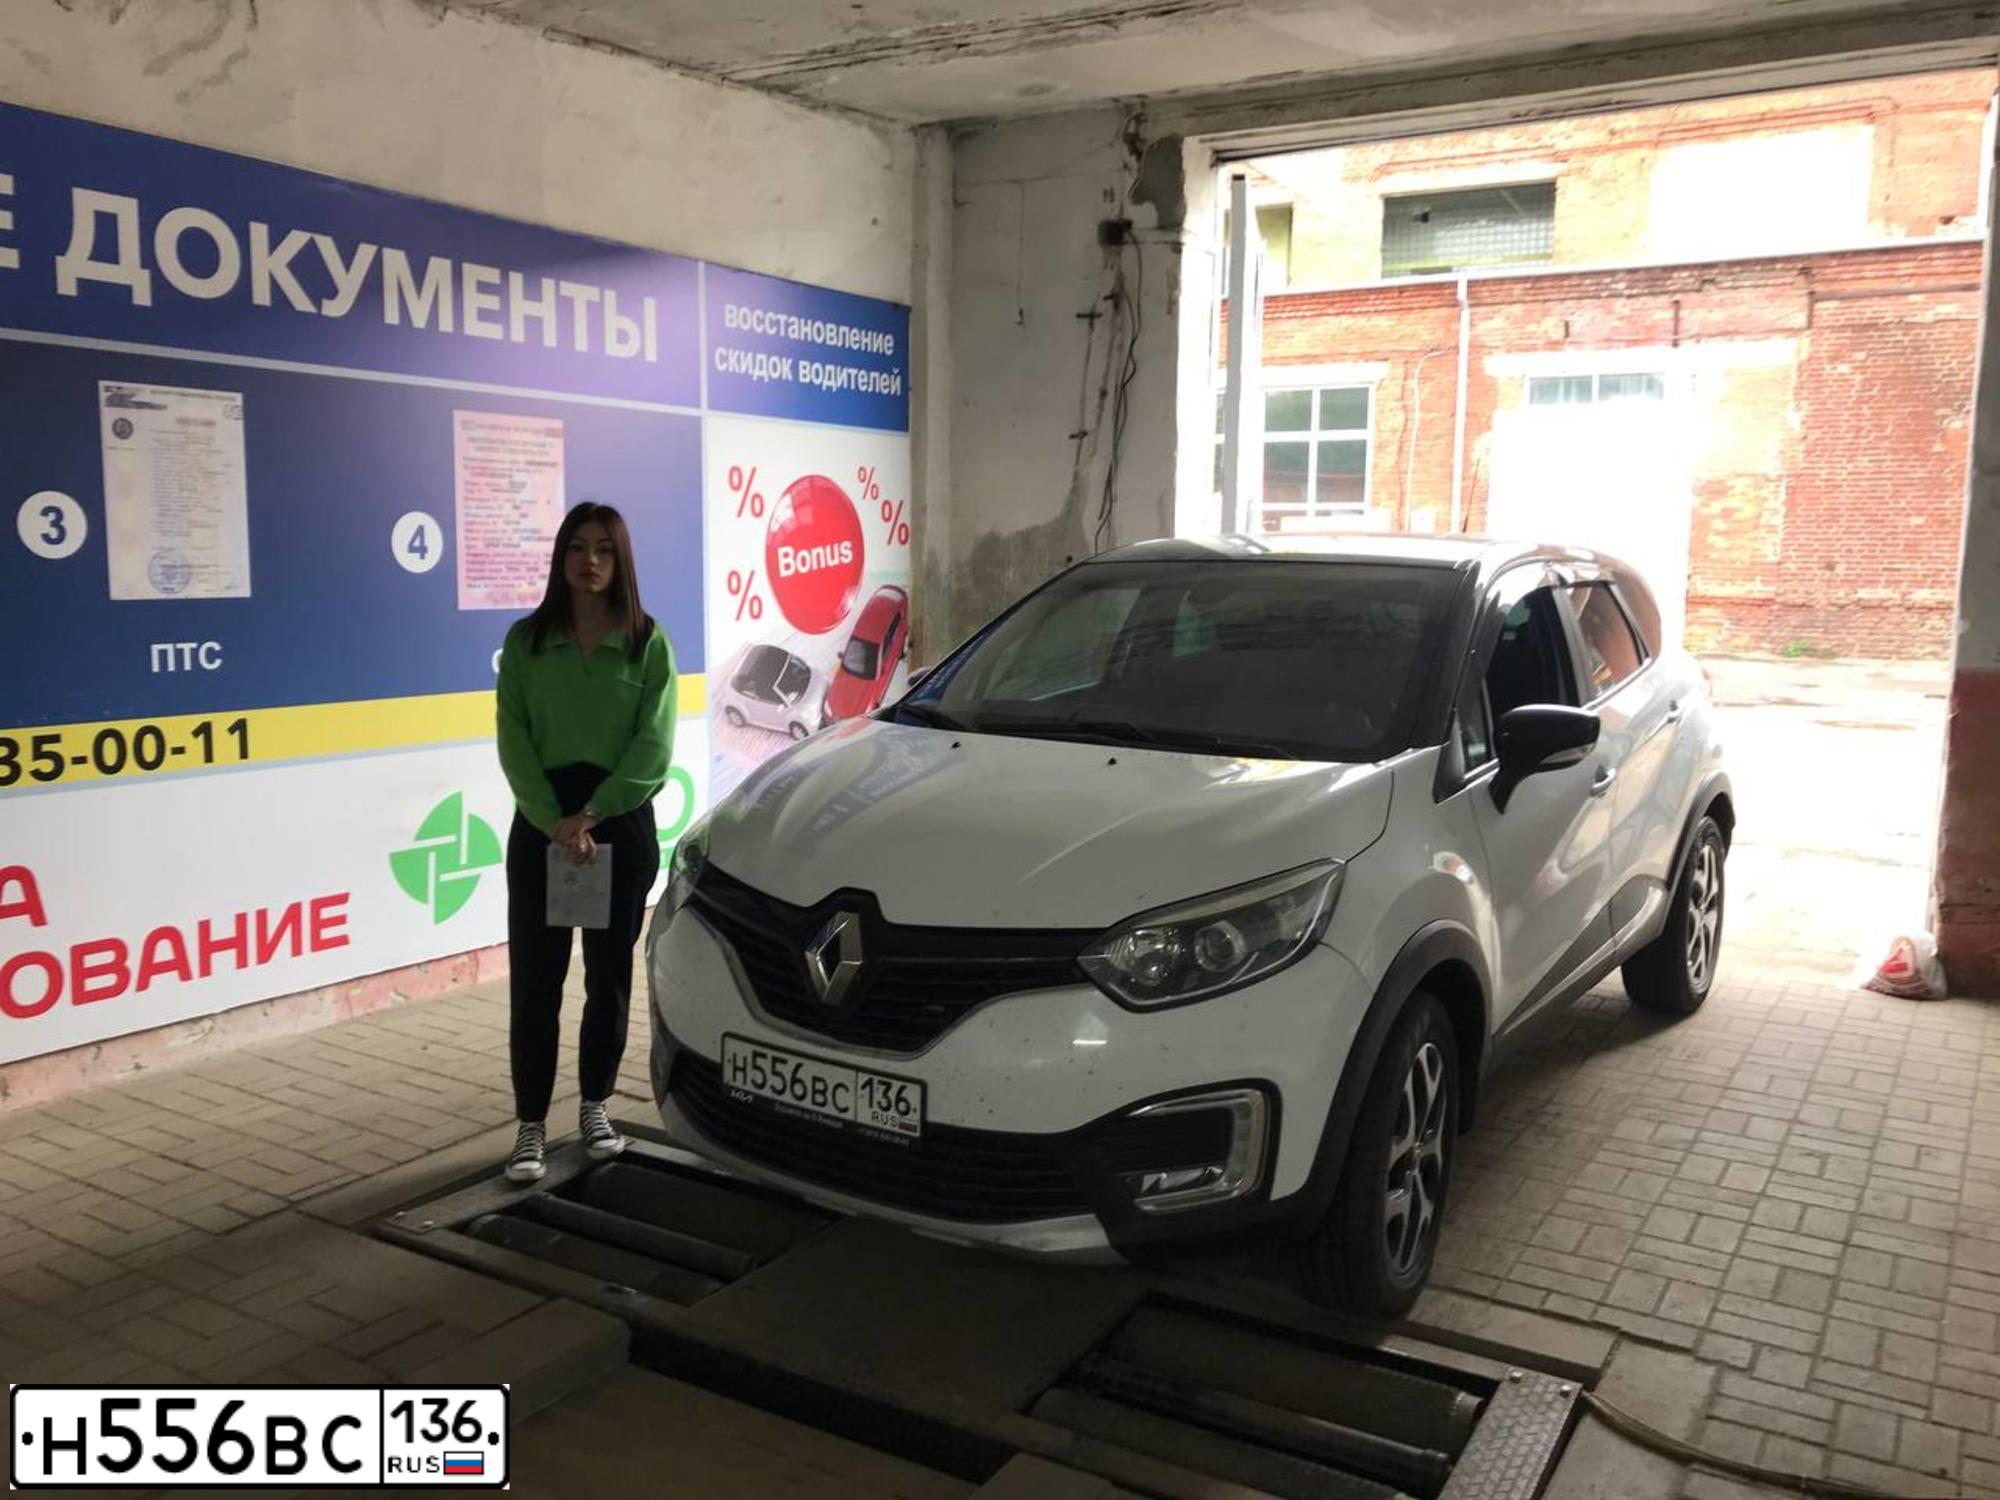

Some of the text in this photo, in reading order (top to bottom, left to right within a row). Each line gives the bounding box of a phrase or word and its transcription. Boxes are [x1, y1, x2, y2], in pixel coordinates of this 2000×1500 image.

[55, 187, 657, 363] ДОКУМЕНТЫ
[715, 346, 902, 397] скидок водителей
[40, 505, 67, 546] 3
[407, 524, 429, 561] 4
[777, 539, 854, 578] Bonus
[150, 641, 224, 673] ПТС
[0, 892, 350, 1019] ОВАНИЕ
[732, 1050, 850, 1114] Н556ВС
[860, 1077, 911, 1117] 136
[871, 1111, 898, 1128] RUS
